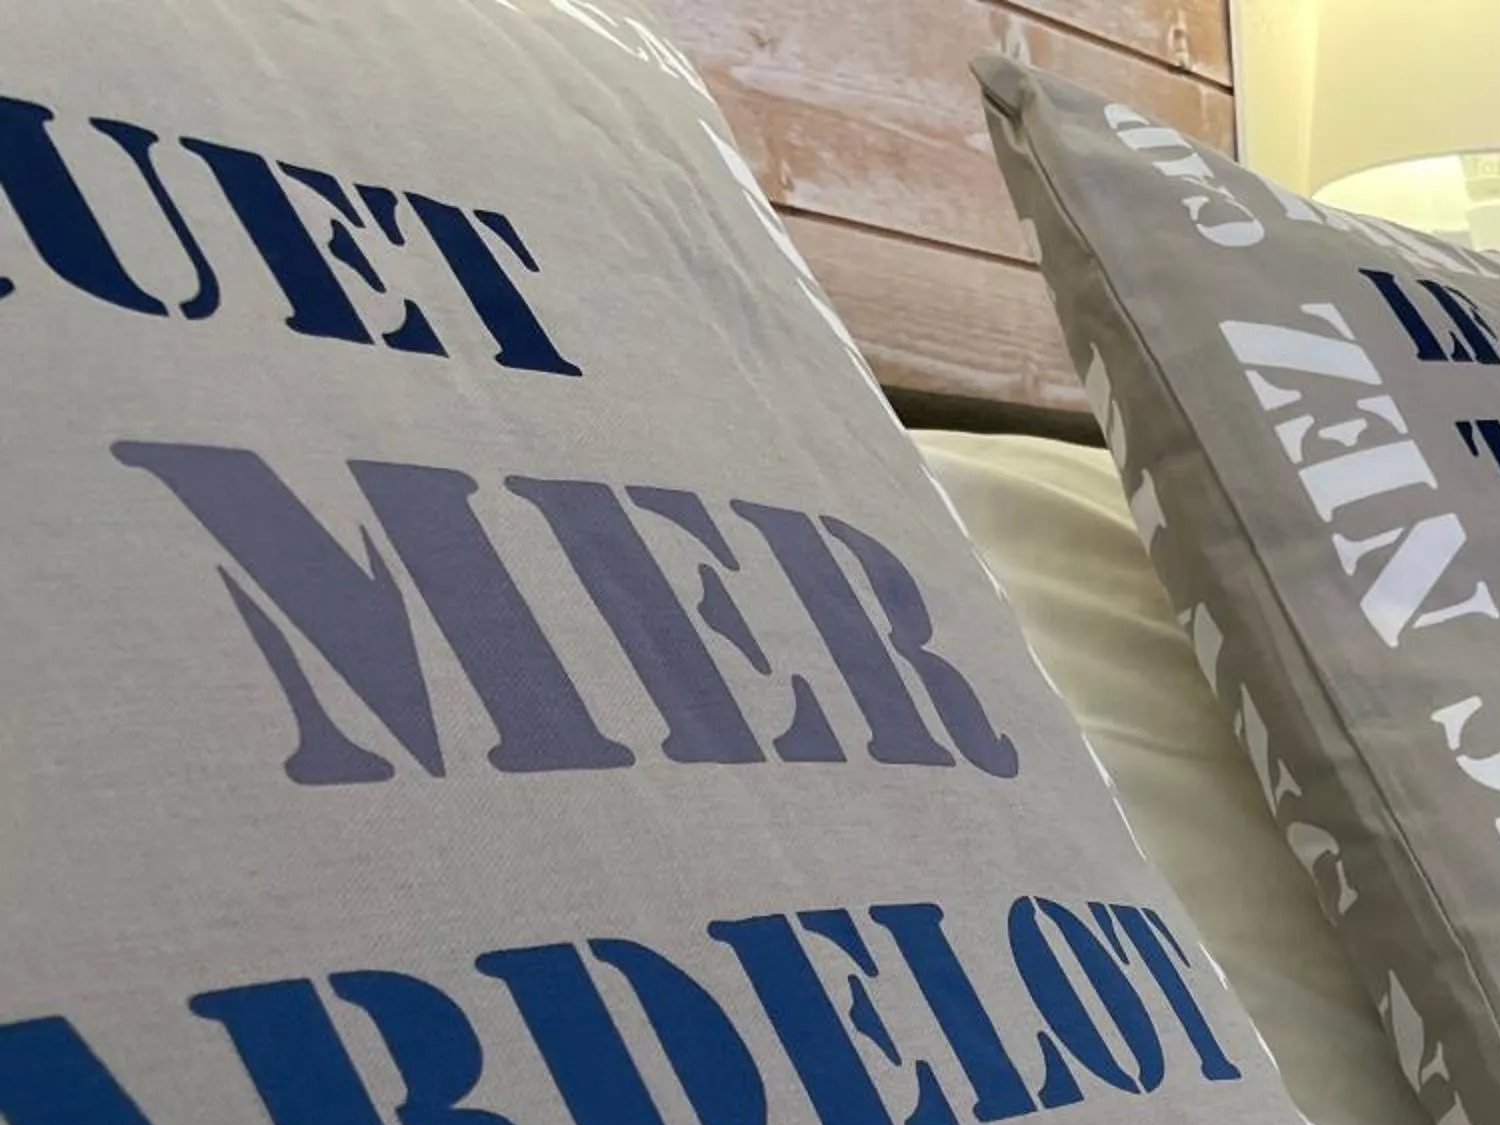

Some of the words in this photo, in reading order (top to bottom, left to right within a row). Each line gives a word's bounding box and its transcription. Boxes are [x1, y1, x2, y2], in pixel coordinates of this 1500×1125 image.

[0, 96, 583, 377] UET
[109, 440, 1019, 784] MER
[1219, 303, 1500, 648] NEZ
